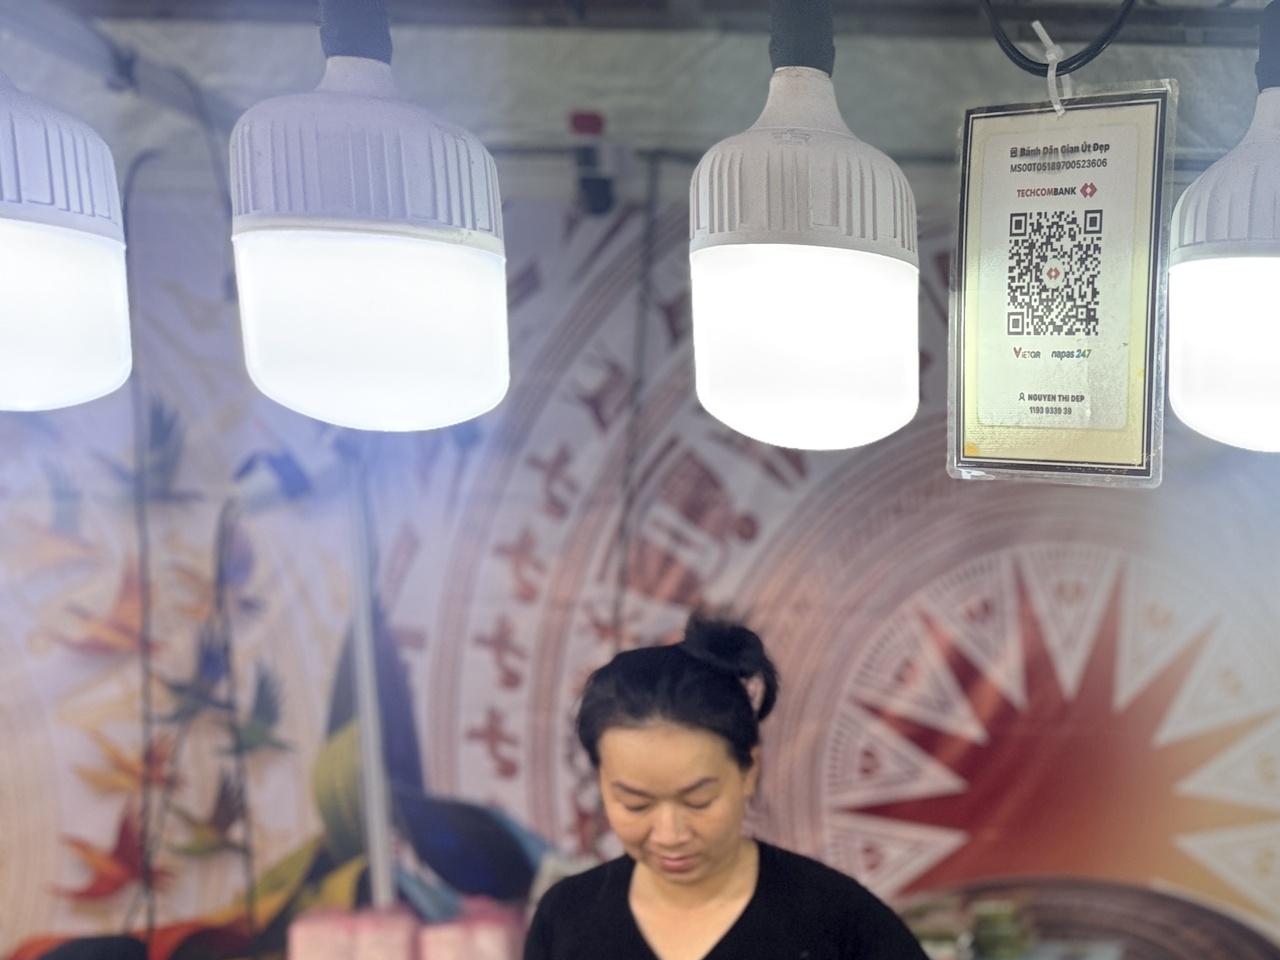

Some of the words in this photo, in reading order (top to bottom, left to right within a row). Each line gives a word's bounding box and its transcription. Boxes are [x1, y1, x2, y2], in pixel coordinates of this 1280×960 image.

[1020, 146, 1040, 157] Bánh
[1042, 145, 1059, 155] Dân
[1060, 144, 1080, 154] Gian
[1081, 141, 1092, 153] Út
[1093, 142, 1110, 154] Đẹp
[1017, 187, 1077, 198] TECHCOMBANK
[1051, 350, 1075, 360] napas
[1075, 348, 1092, 359] 247
[1028, 393, 1056, 402] NGUYEN
[1058, 394, 1070, 402] THI
[1029, 406, 1044, 414] 1193
[1063, 407, 1072, 415] 39
